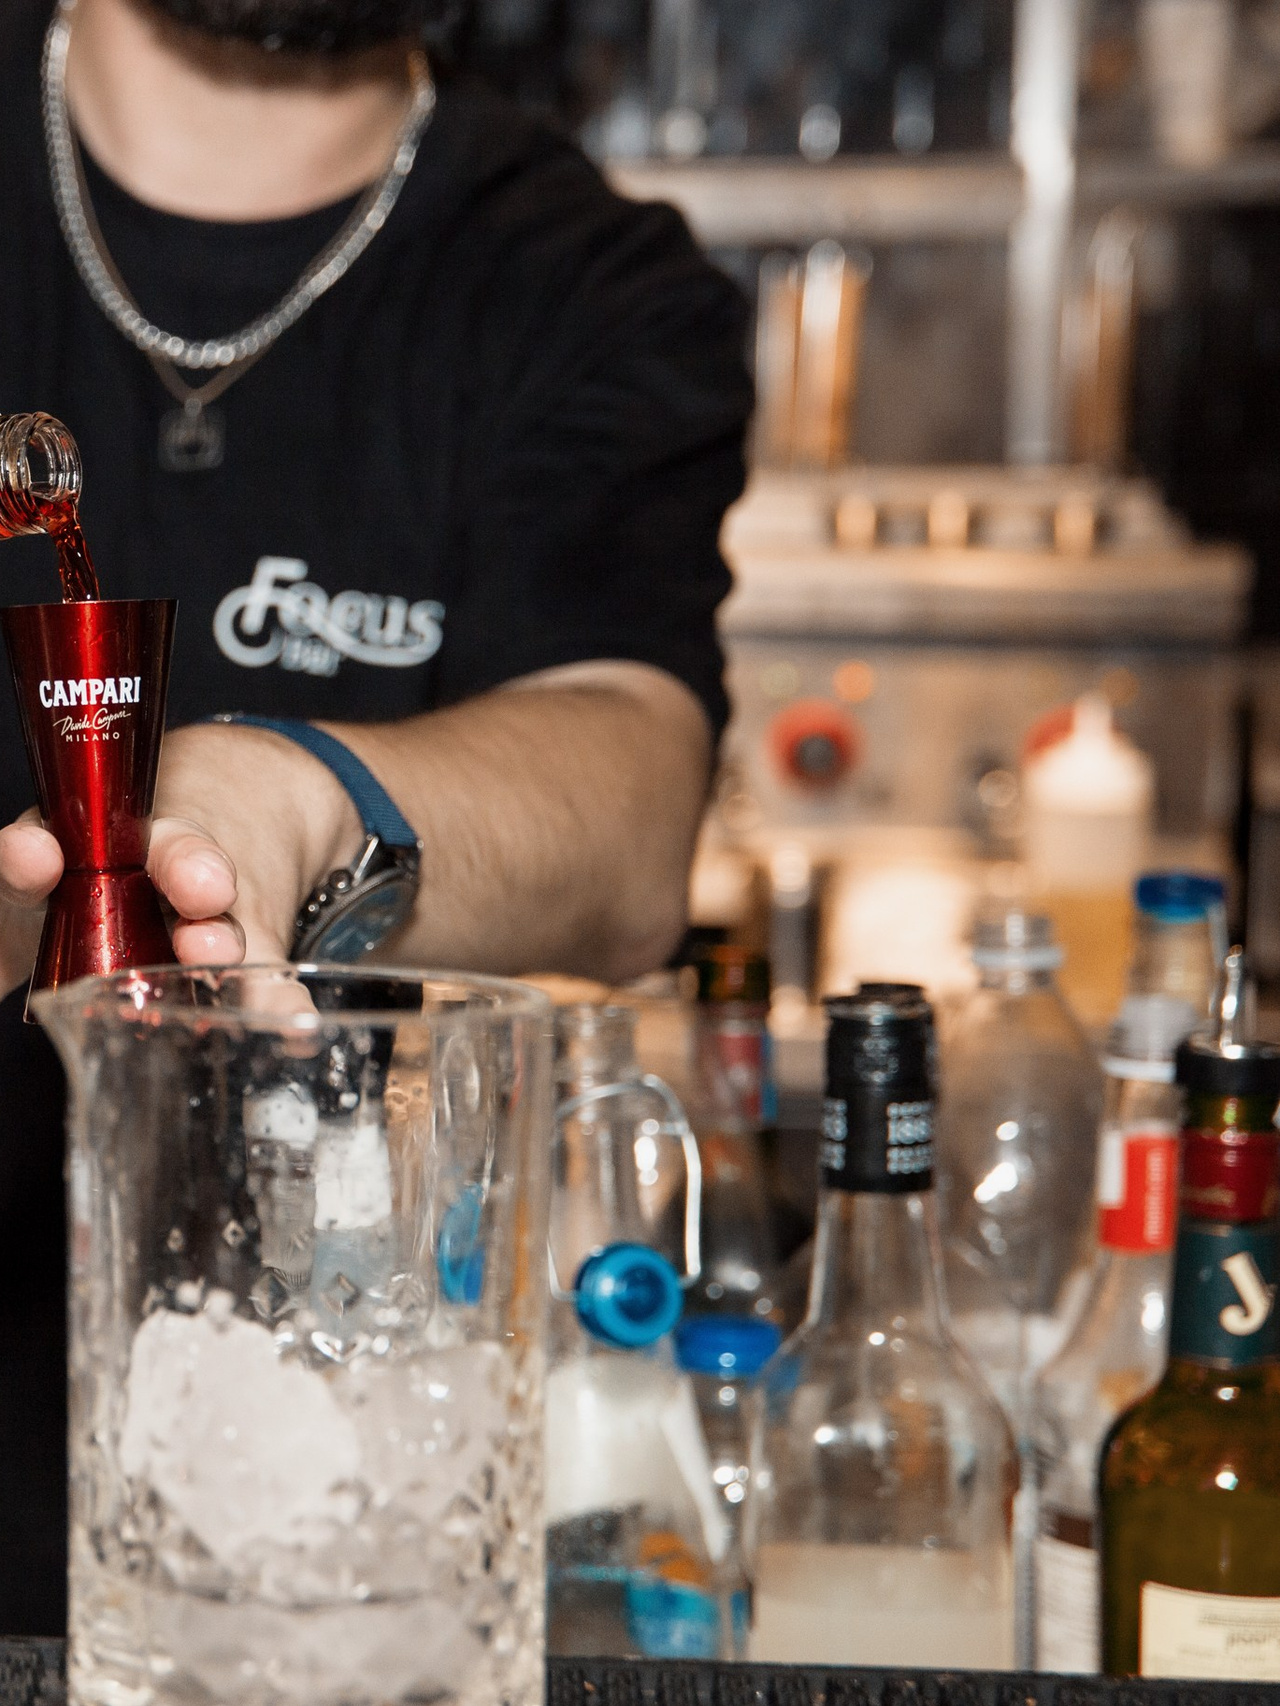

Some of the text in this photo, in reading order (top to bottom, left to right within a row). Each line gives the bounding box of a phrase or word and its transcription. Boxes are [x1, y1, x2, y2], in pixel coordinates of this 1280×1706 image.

[38, 676, 142, 709] CAMPARI
[53, 705, 132, 736] Davide Campari
[65, 731, 121, 743] MILANO
[1220, 1251, 1270, 1337] J
